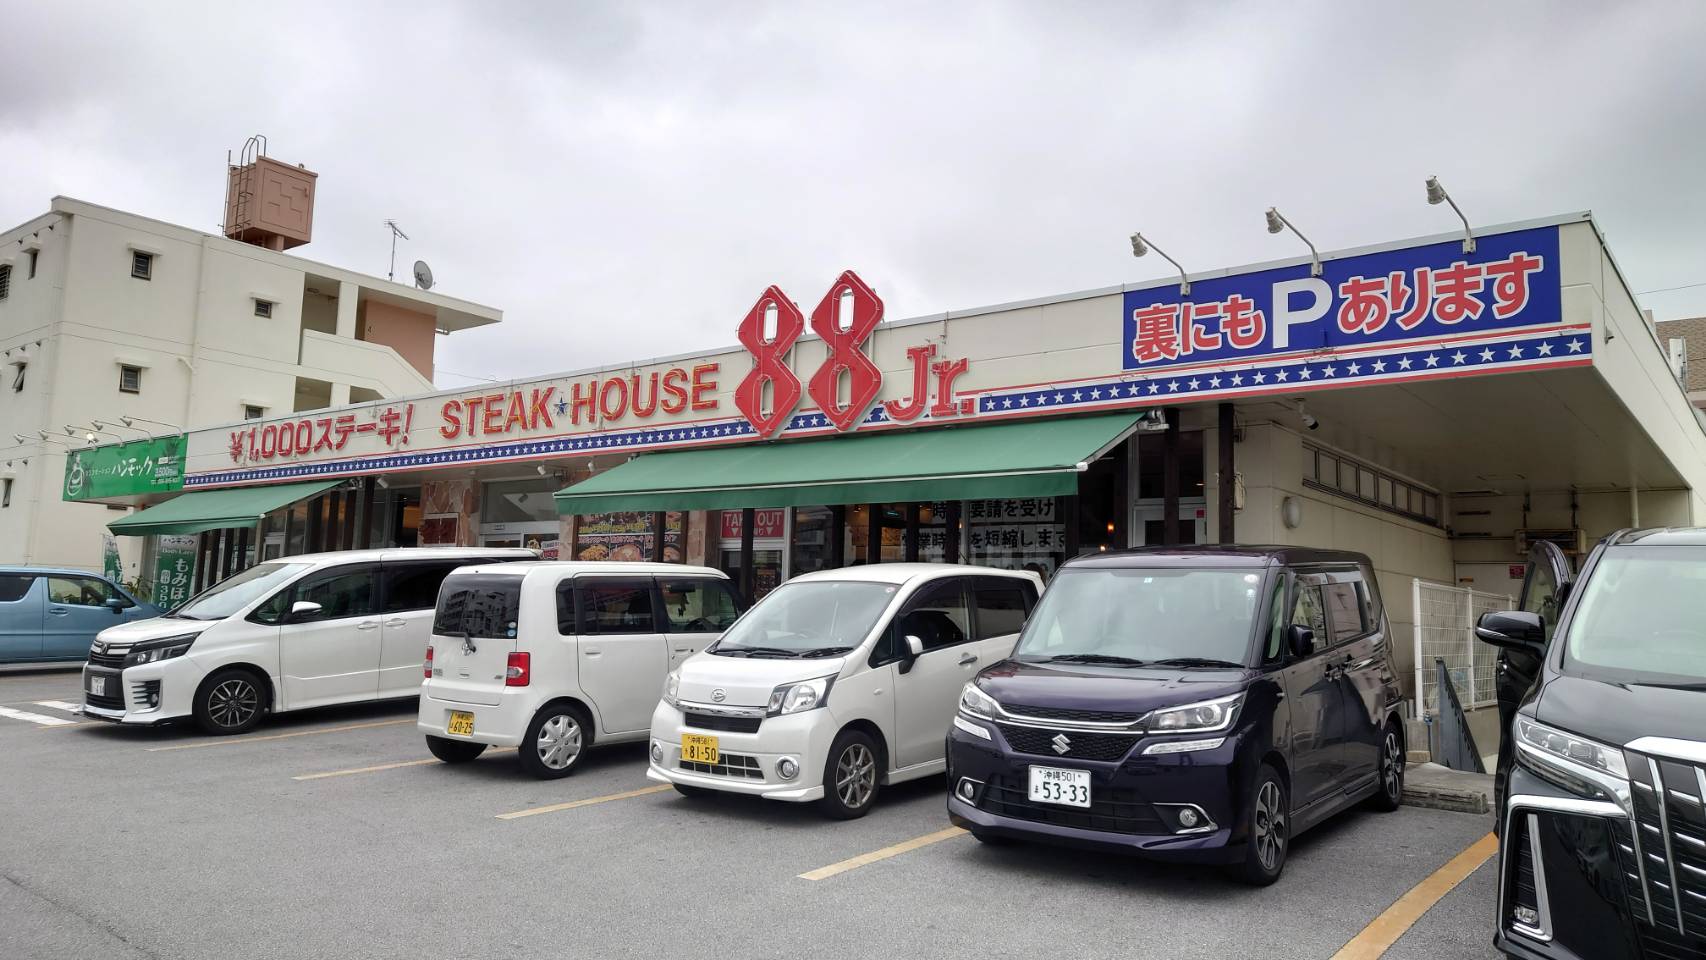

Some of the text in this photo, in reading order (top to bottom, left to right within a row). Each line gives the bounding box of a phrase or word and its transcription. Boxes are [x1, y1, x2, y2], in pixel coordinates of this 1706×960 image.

[1133, 252, 1545, 363] 裏にもPあります
[440, 270, 975, 440] STEAK HOUSE 88 Jr.
[111, 456, 152, 477] ハンモック
[757, 511, 782, 526] OUT
[933, 501, 1054, 518] 時要請を受け
[1042, 781, 1088, 803] 53-33
